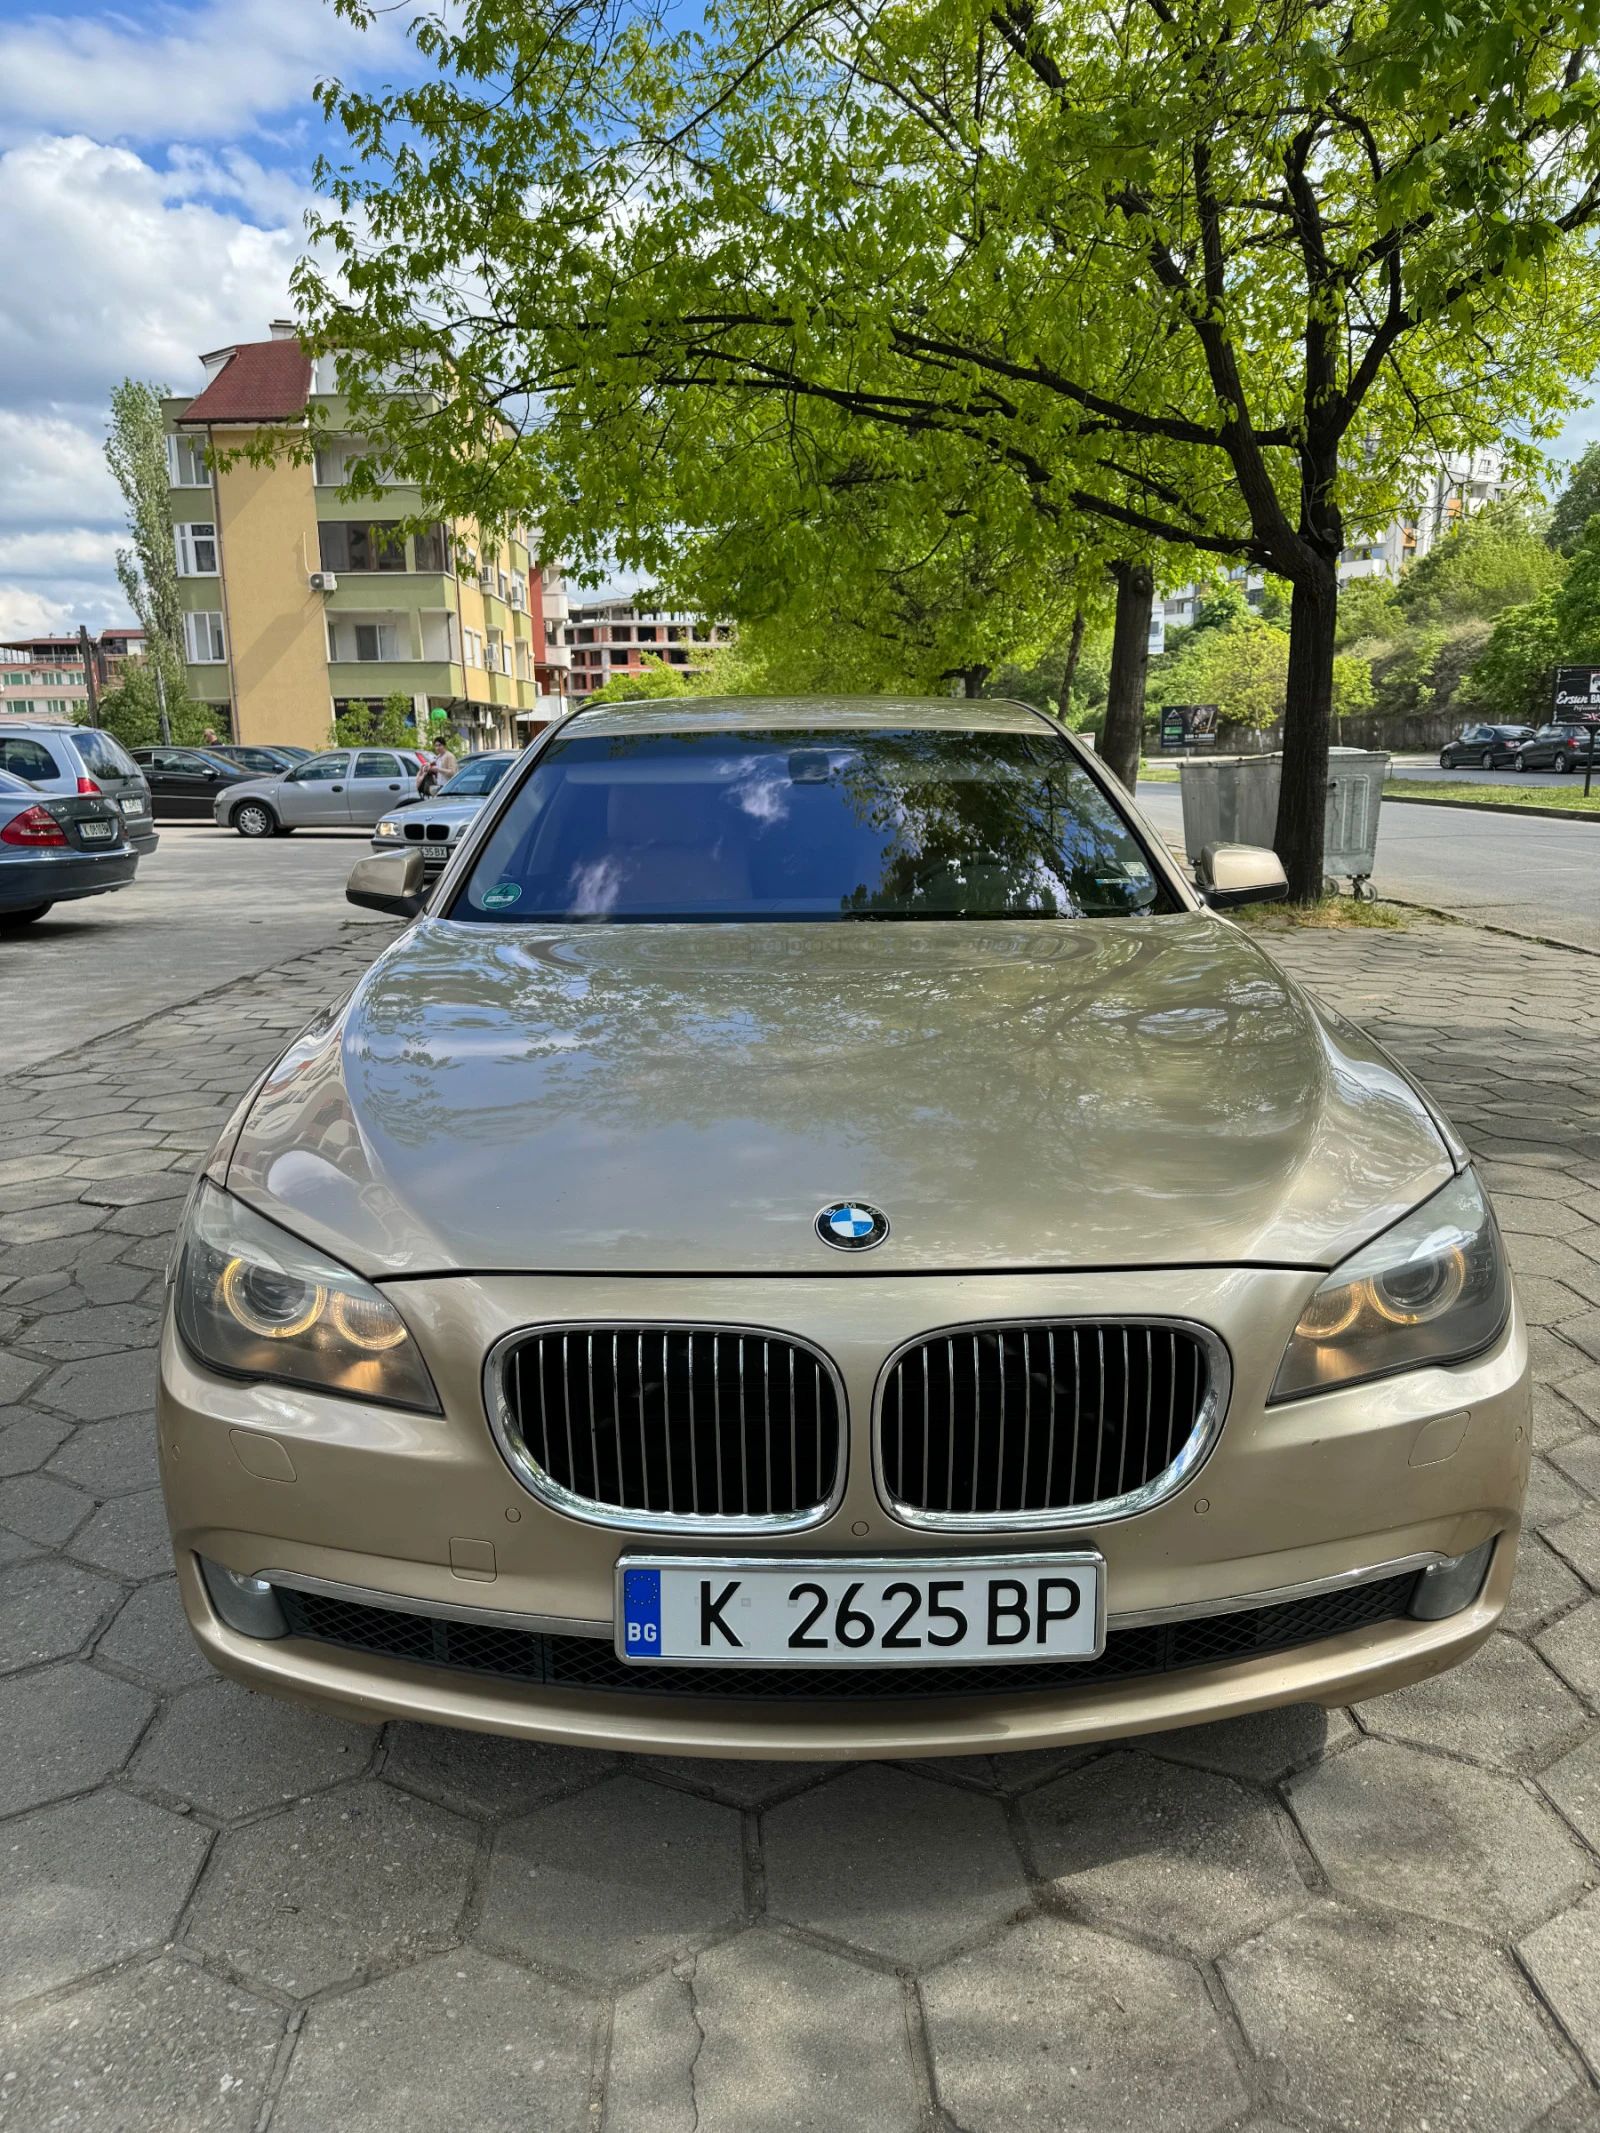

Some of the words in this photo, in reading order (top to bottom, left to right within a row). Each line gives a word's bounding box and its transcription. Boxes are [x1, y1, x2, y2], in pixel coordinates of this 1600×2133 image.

[823, 1202, 881, 1217] BMW
[700, 1580, 743, 1647] K
[788, 1582, 968, 1649] 2625
[627, 1622, 657, 1642] BG
